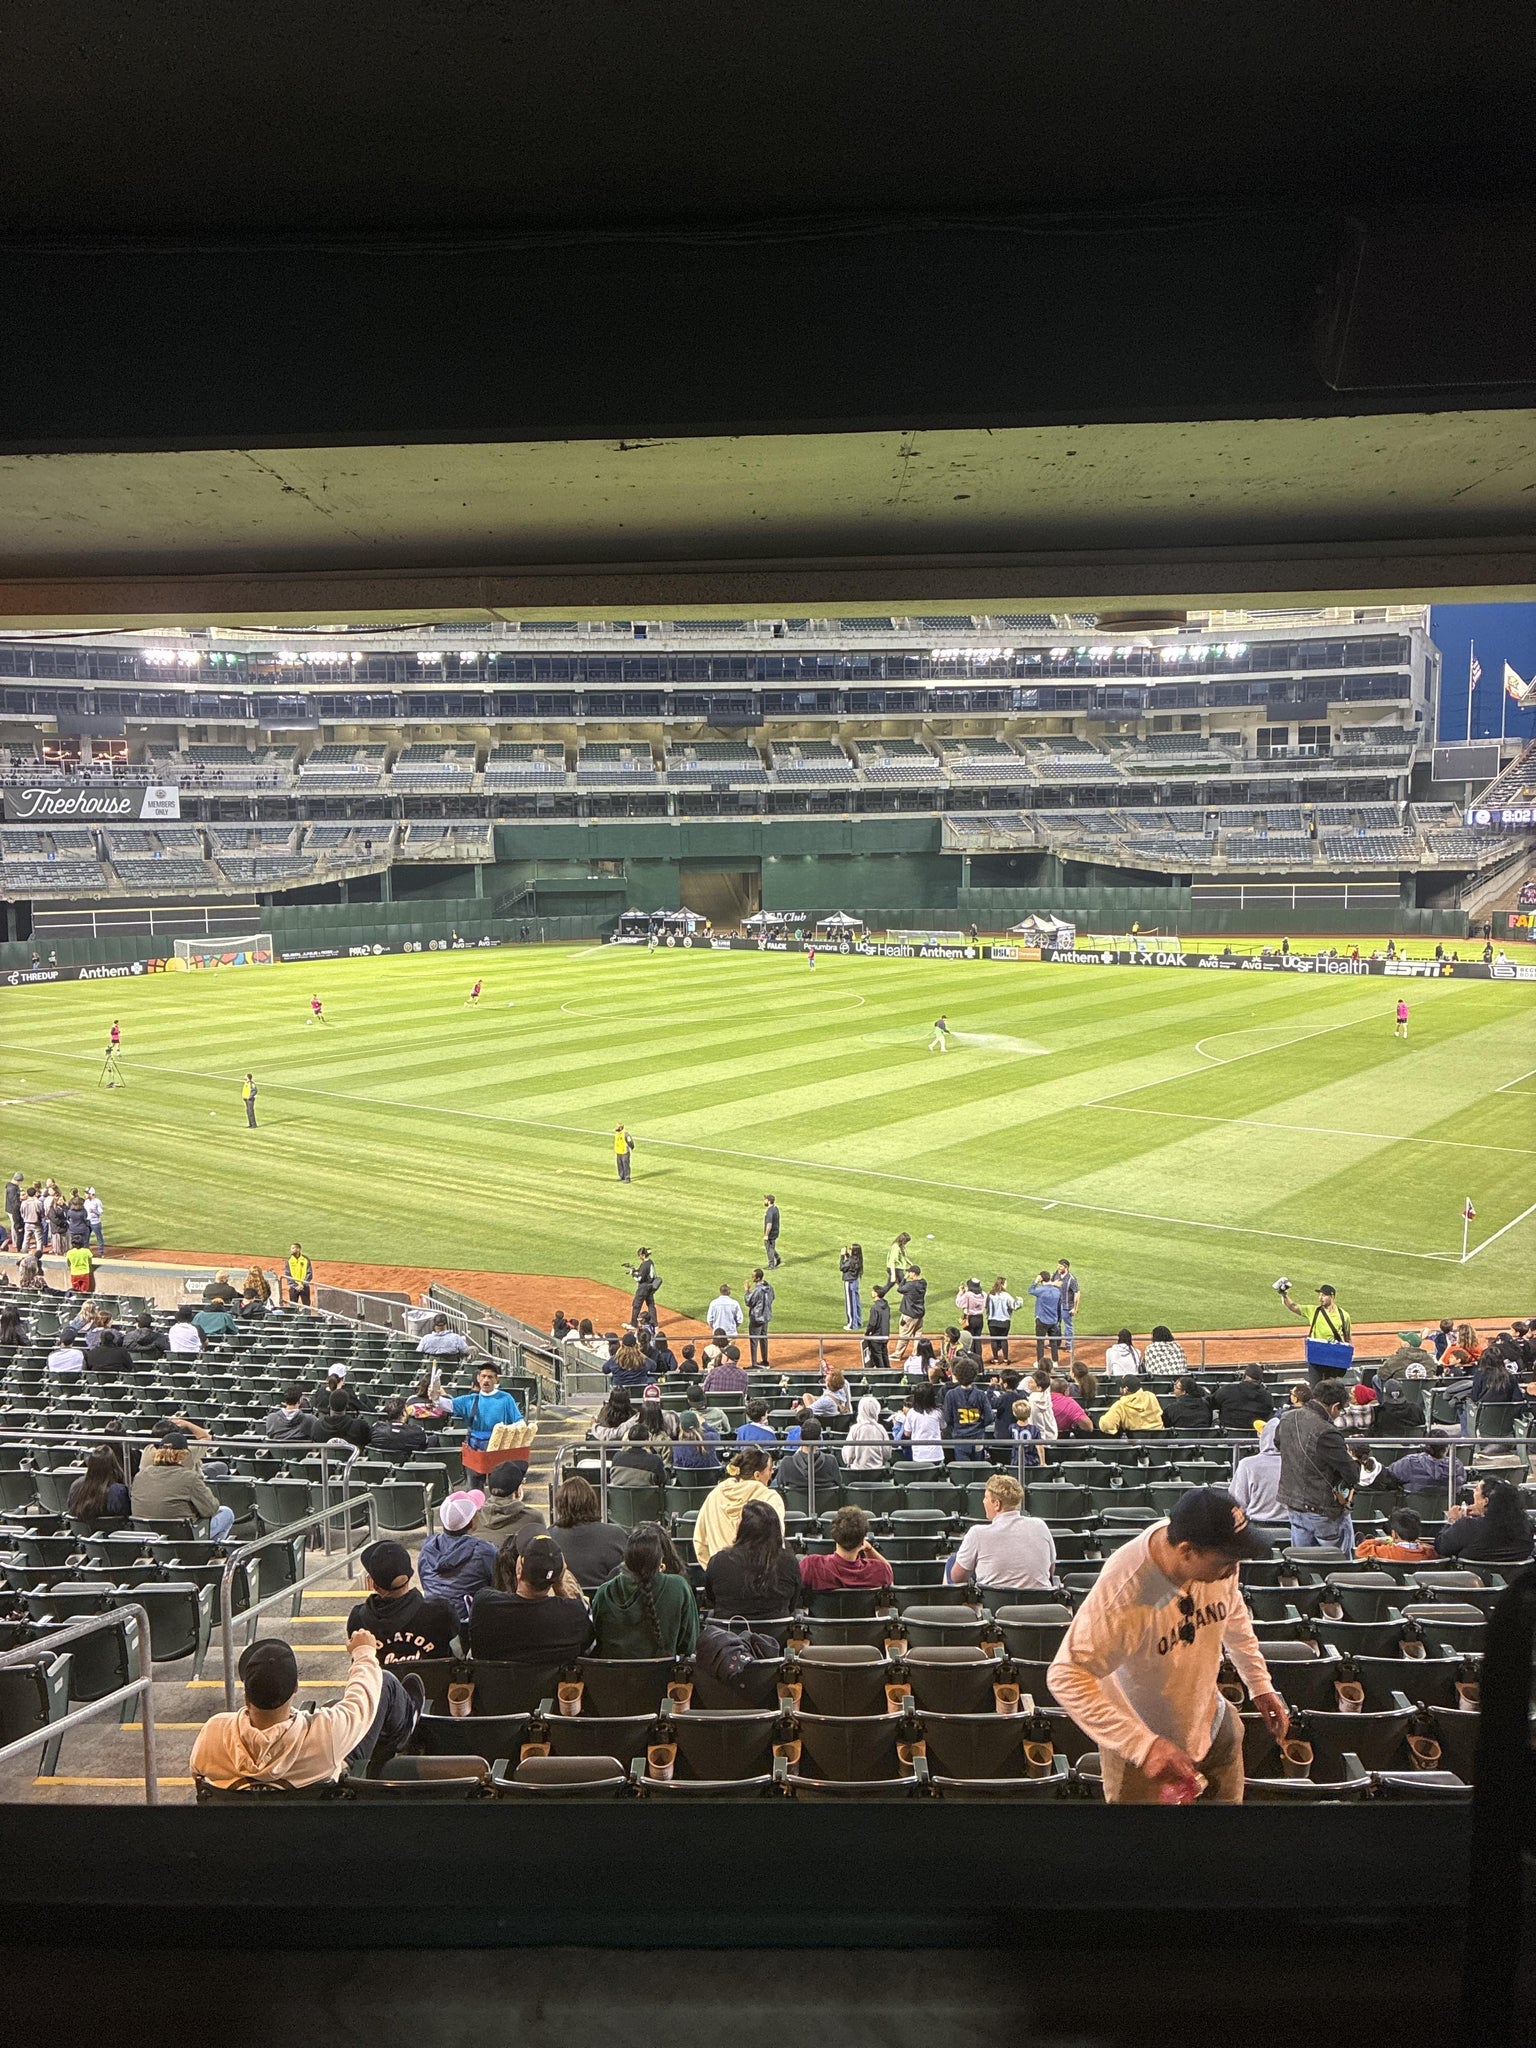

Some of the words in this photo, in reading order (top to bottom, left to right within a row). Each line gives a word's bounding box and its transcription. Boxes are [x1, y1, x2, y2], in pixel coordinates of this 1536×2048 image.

[16, 787, 132, 818] Treehouse
[147, 800, 176, 809] MEMBERS
[155, 808, 169, 816] ONLY
[1501, 809, 1531, 823] 8:02
[1508, 914, 1536, 928] FAI
[855, 942, 878, 956] UCSF
[878, 942, 915, 957] Health
[919, 947, 964, 959] Anthem
[1050, 950, 1101, 964] Anthem
[1156, 953, 1188, 967] OAK
[78, 965, 130, 980] Anthem
[1282, 956, 1314, 973] UCSF
[1315, 956, 1370, 975] Health
[20, 970, 59, 982] THREDUP
[1158, 1601, 1227, 1656] OAAND
